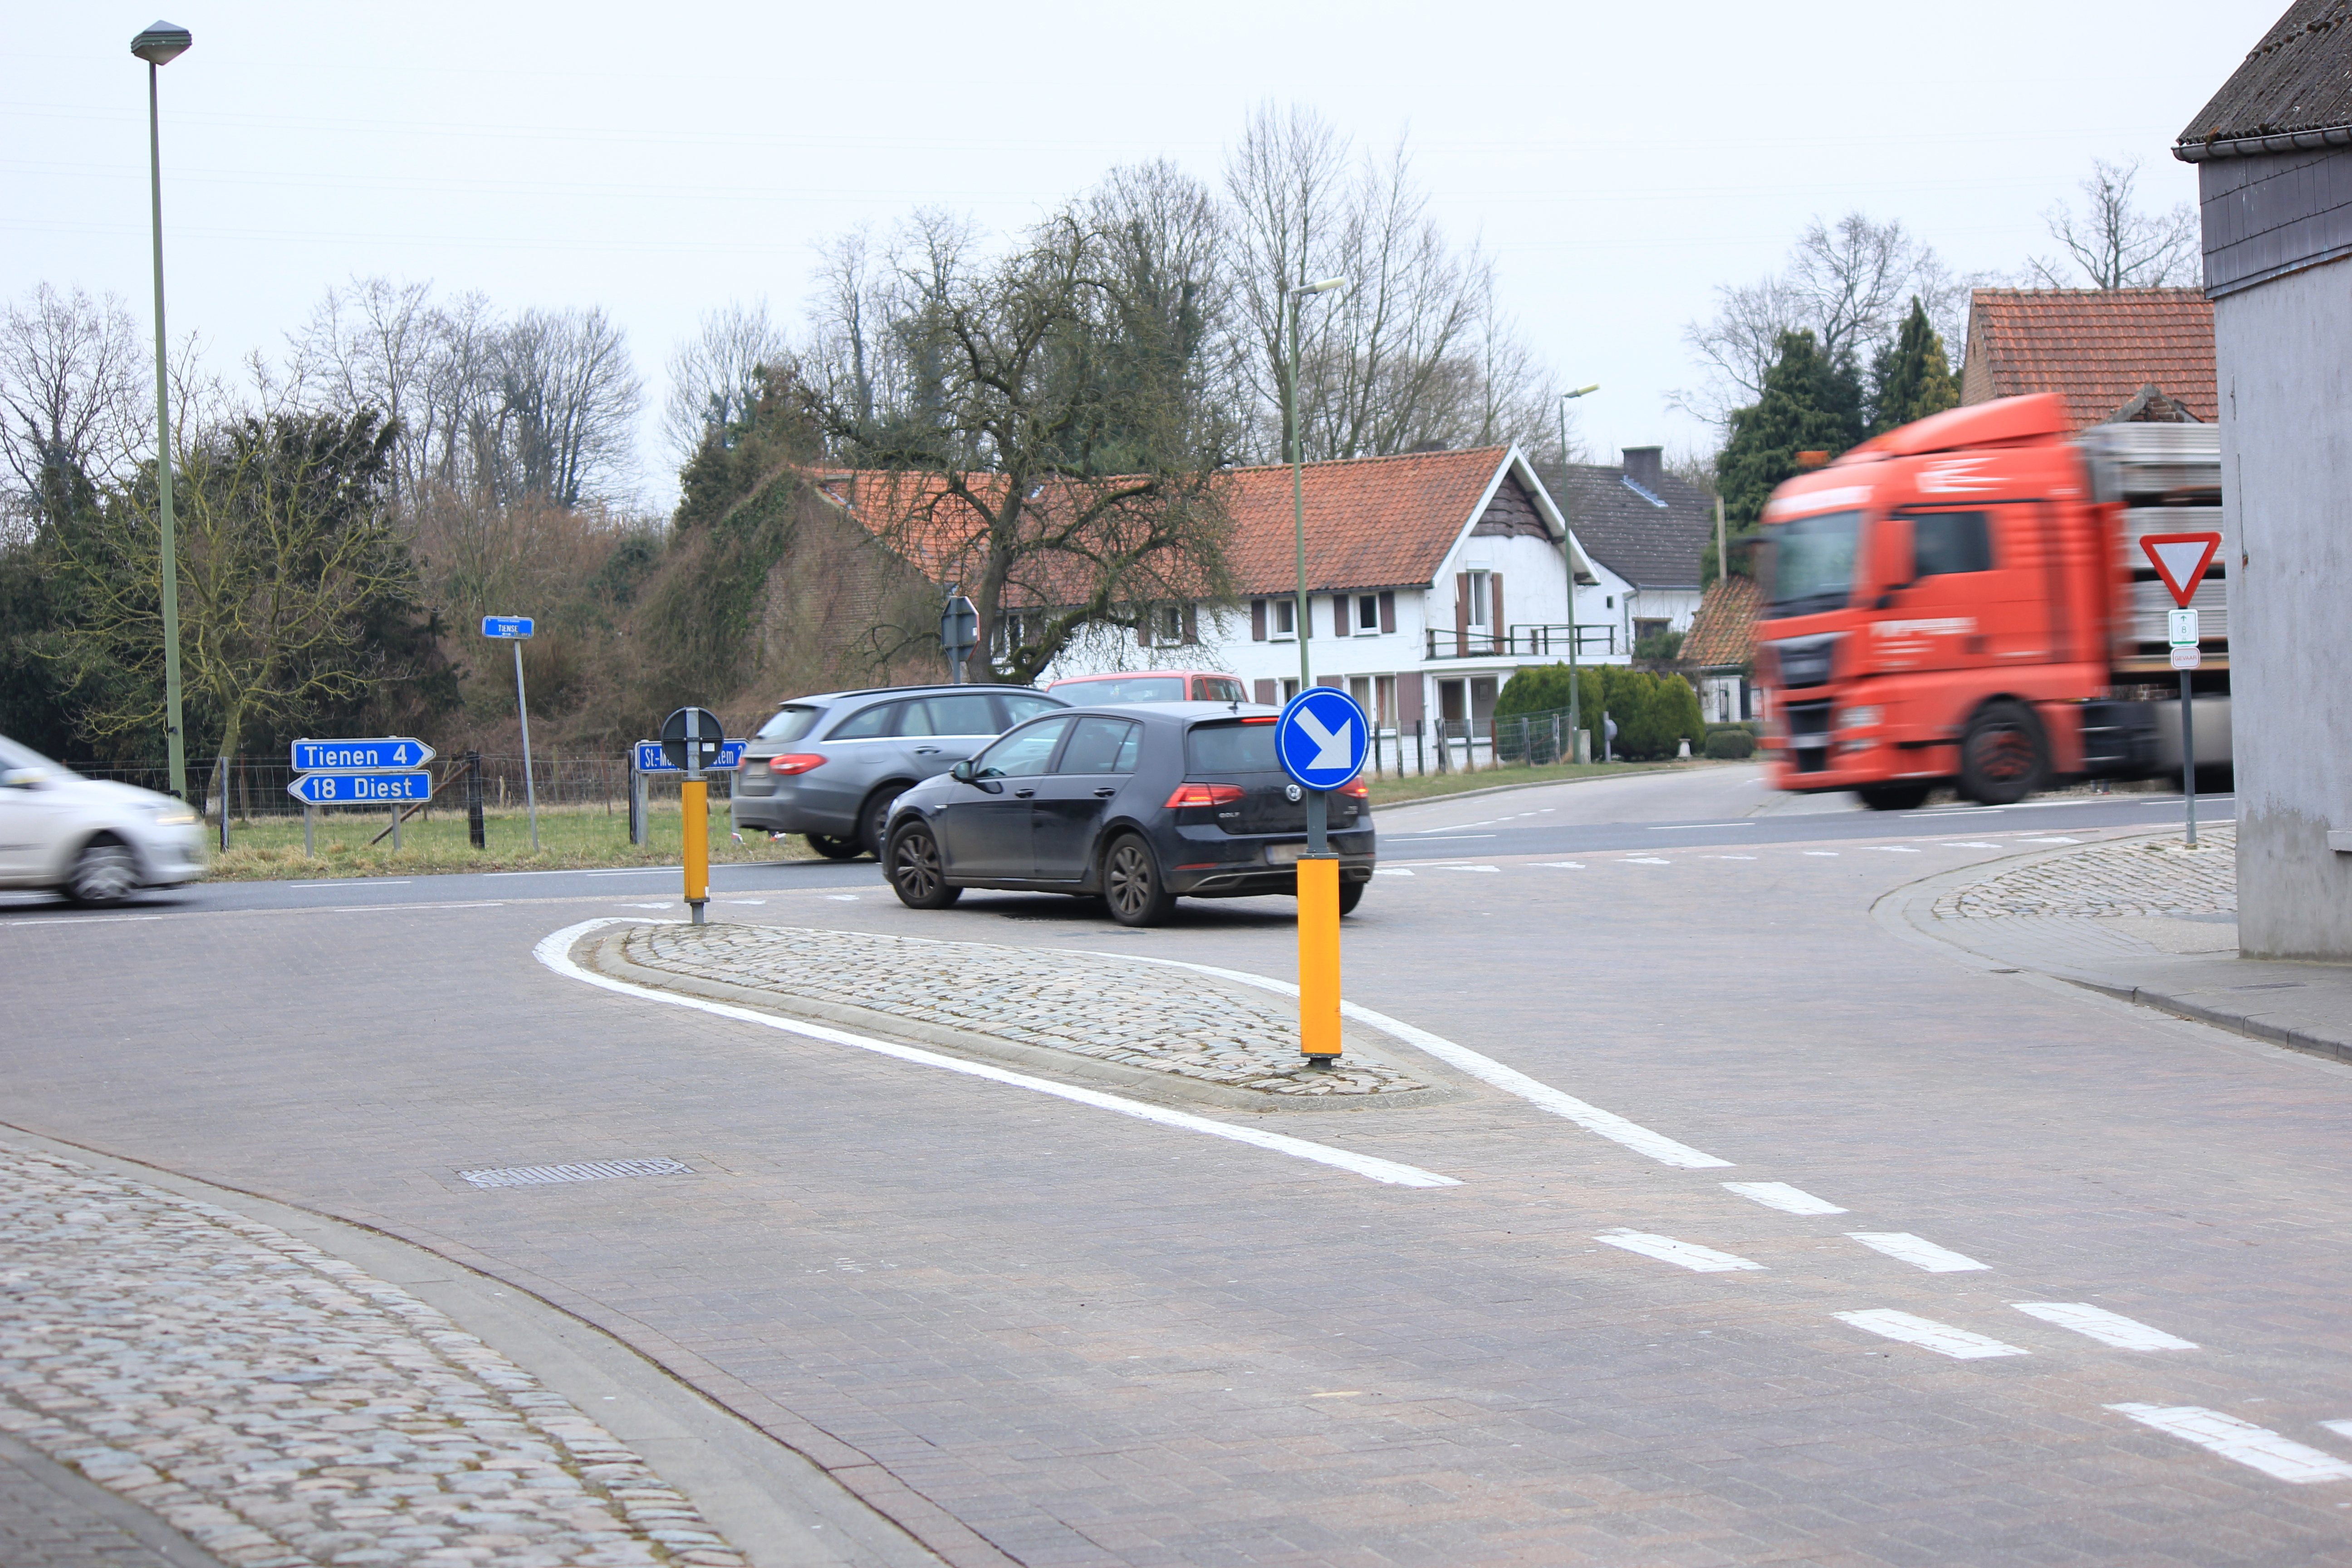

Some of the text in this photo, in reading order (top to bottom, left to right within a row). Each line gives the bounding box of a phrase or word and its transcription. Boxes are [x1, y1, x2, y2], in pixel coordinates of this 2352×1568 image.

[304, 744, 407, 766] Tienen 4
[313, 777, 412, 799] 18 Diest
